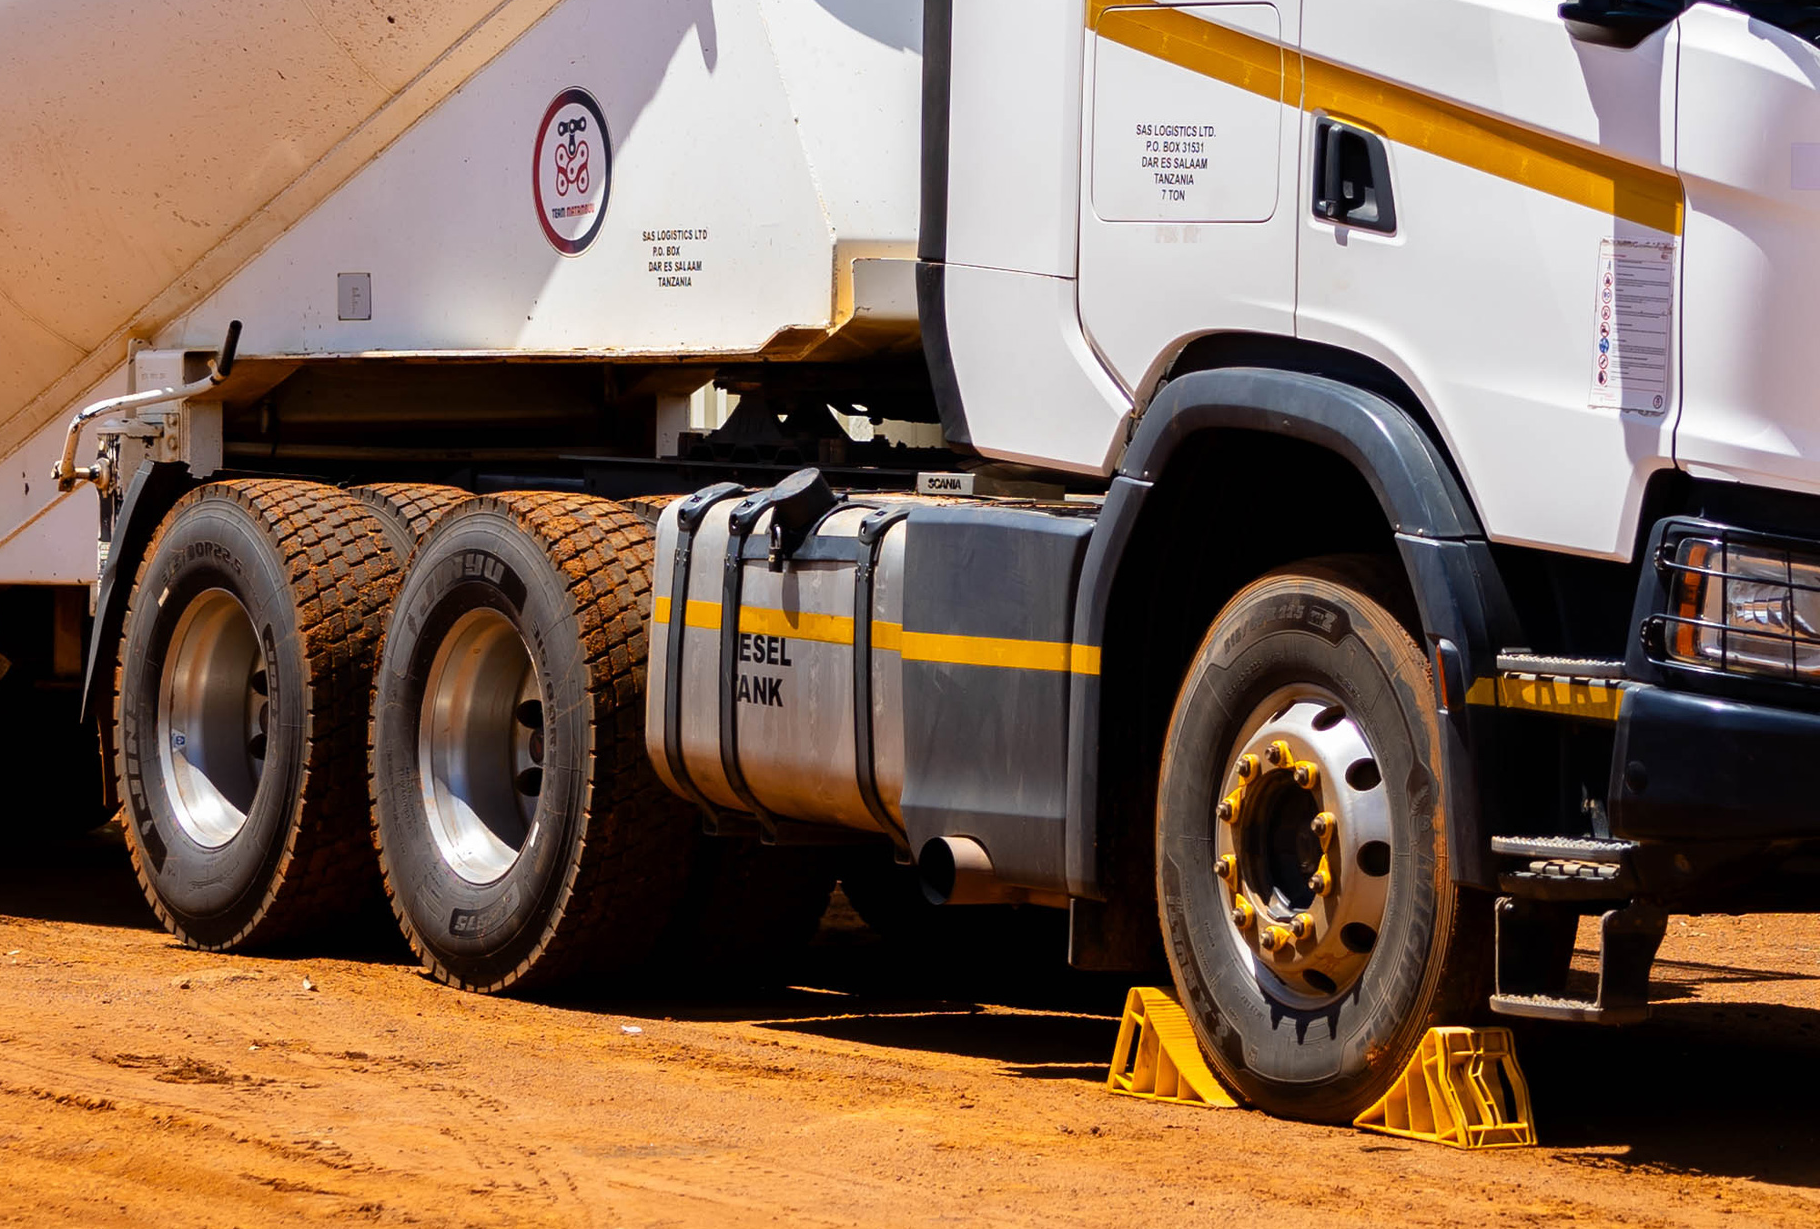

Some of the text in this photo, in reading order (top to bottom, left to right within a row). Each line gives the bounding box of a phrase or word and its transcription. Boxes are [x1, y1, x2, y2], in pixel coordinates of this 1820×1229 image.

[1136, 124, 1216, 138] SAS LOGISTICS LTD.
[1163, 141, 1181, 153] BOX
[1182, 142, 1205, 154] 31531
[1141, 157, 1208, 169] DAR ES SALAAM
[1154, 173, 1194, 185] TANZANIA
[1161, 189, 1186, 201] 7 TON
[642, 229, 708, 241] SAS LOGISTICS LTD
[666, 246, 680, 256] BOX
[648, 261, 702, 272] DAR ES SALAAM
[658, 276, 692, 287] TANZANIA
[927, 477, 962, 490] SCANIA
[738, 632, 792, 667] ESEL
